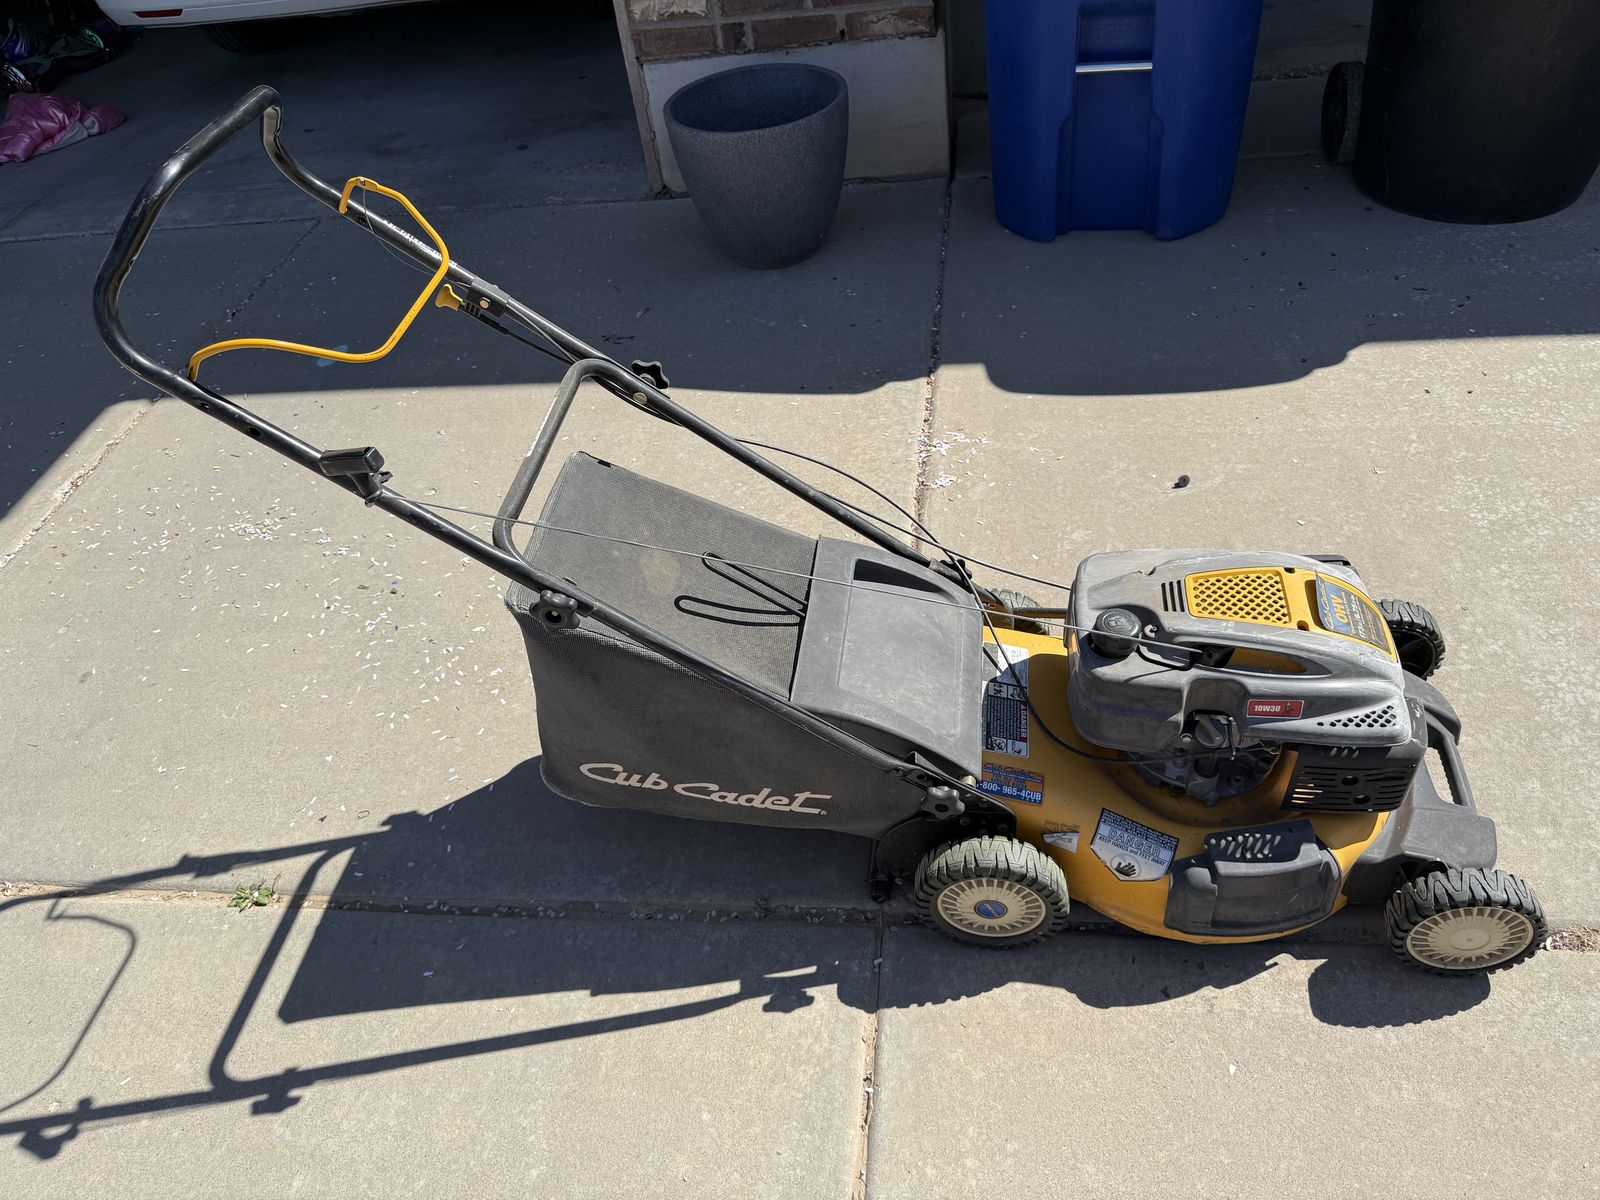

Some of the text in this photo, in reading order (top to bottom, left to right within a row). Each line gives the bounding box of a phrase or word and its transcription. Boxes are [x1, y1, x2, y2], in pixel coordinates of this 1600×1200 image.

[1330, 593, 1348, 623] OHV
[1254, 704, 1281, 712] 10W30
[579, 763, 832, 815] Cub Cadet
[1099, 836, 1166, 866] KEEP HANDS and FEET AWAY
[1108, 827, 1161, 857] DANGER
